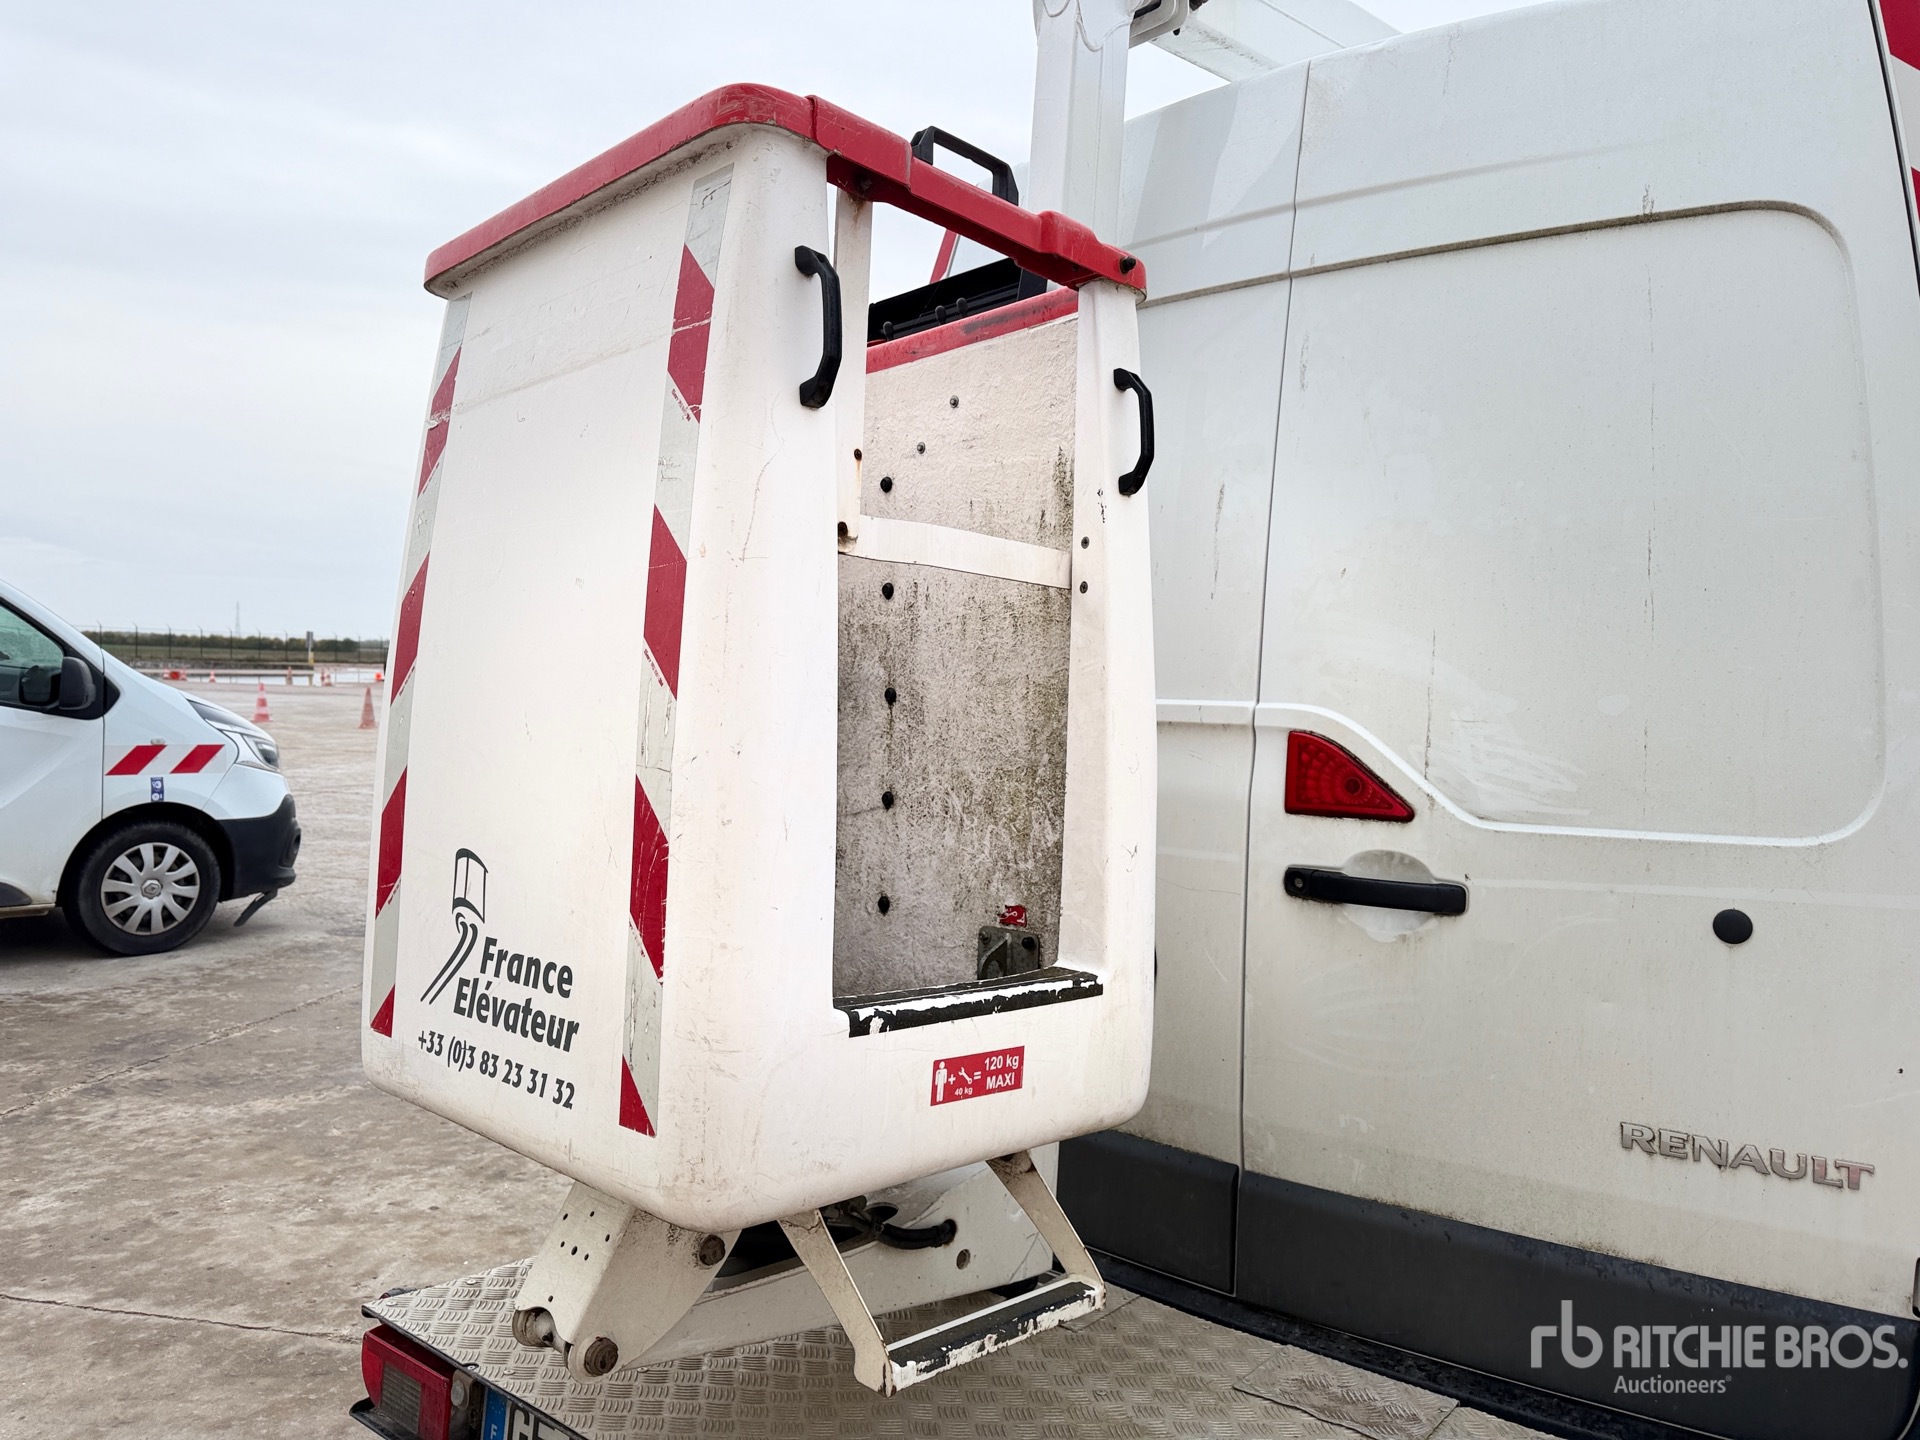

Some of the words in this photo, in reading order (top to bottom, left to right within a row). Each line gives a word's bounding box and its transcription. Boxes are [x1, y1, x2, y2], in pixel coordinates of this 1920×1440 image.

[479, 936, 573, 999] France
[453, 976, 580, 1052] Elévateur
[418, 1030, 444, 1057] +33
[447, 1035, 476, 1072] (0)3
[479, 1050, 500, 1079] 83
[502, 1059, 523, 1088] 23
[526, 1068, 548, 1098] 31
[552, 1077, 575, 1110] 32
[954, 1087, 963, 1096] 40
[964, 1086, 973, 1095] kg
[984, 1055, 1003, 1071] 120
[1006, 1054, 1019, 1069] kg
[986, 1072, 1015, 1090] MAXI
[1620, 1121, 1875, 1191] RENAULT
